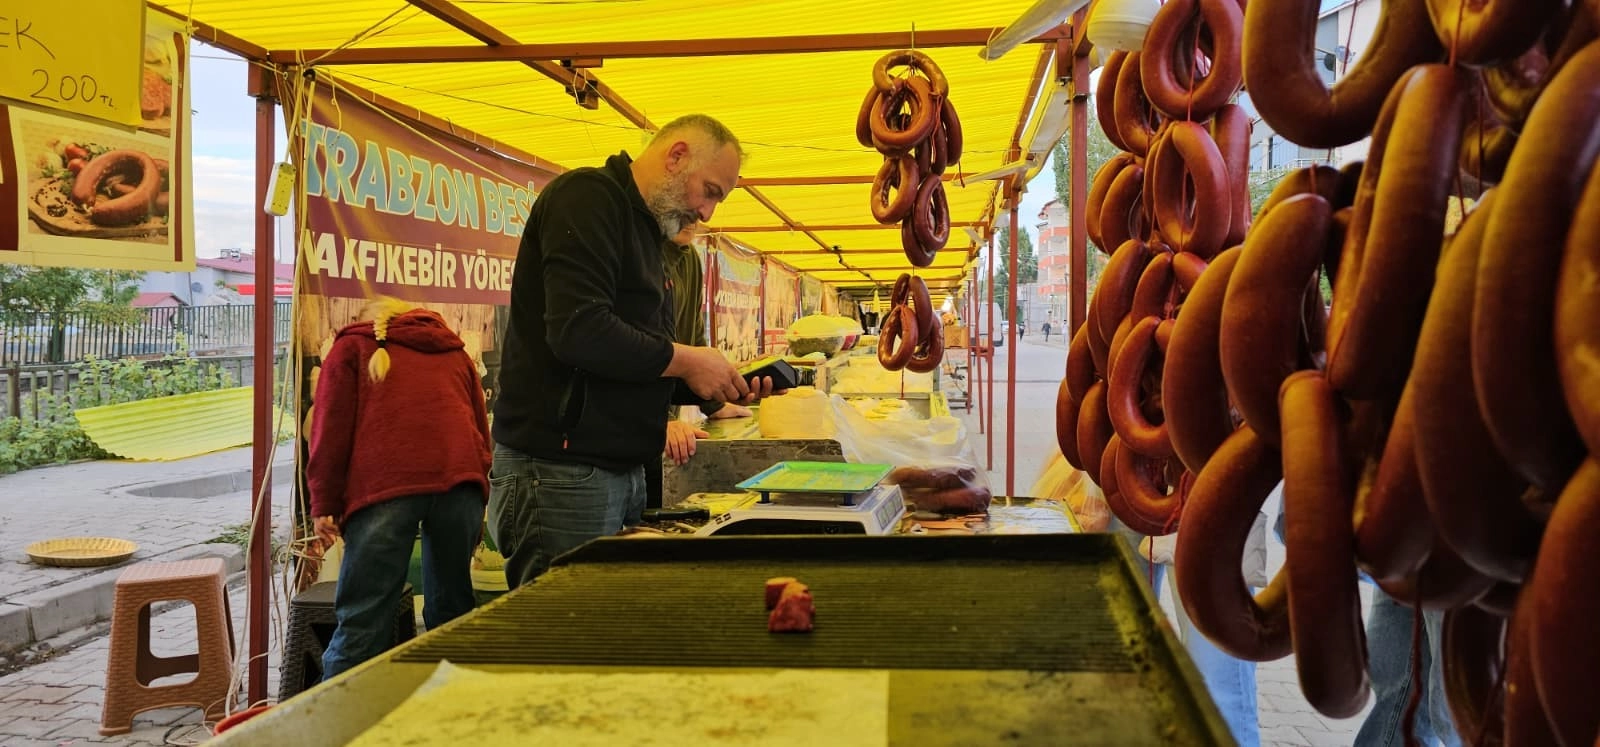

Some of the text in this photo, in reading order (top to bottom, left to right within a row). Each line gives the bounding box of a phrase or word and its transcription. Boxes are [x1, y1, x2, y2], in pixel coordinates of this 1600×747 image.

[30, 69, 97, 102] 200
[299, 119, 479, 230] TRABZON
[462, 248, 516, 291] YÖRE
